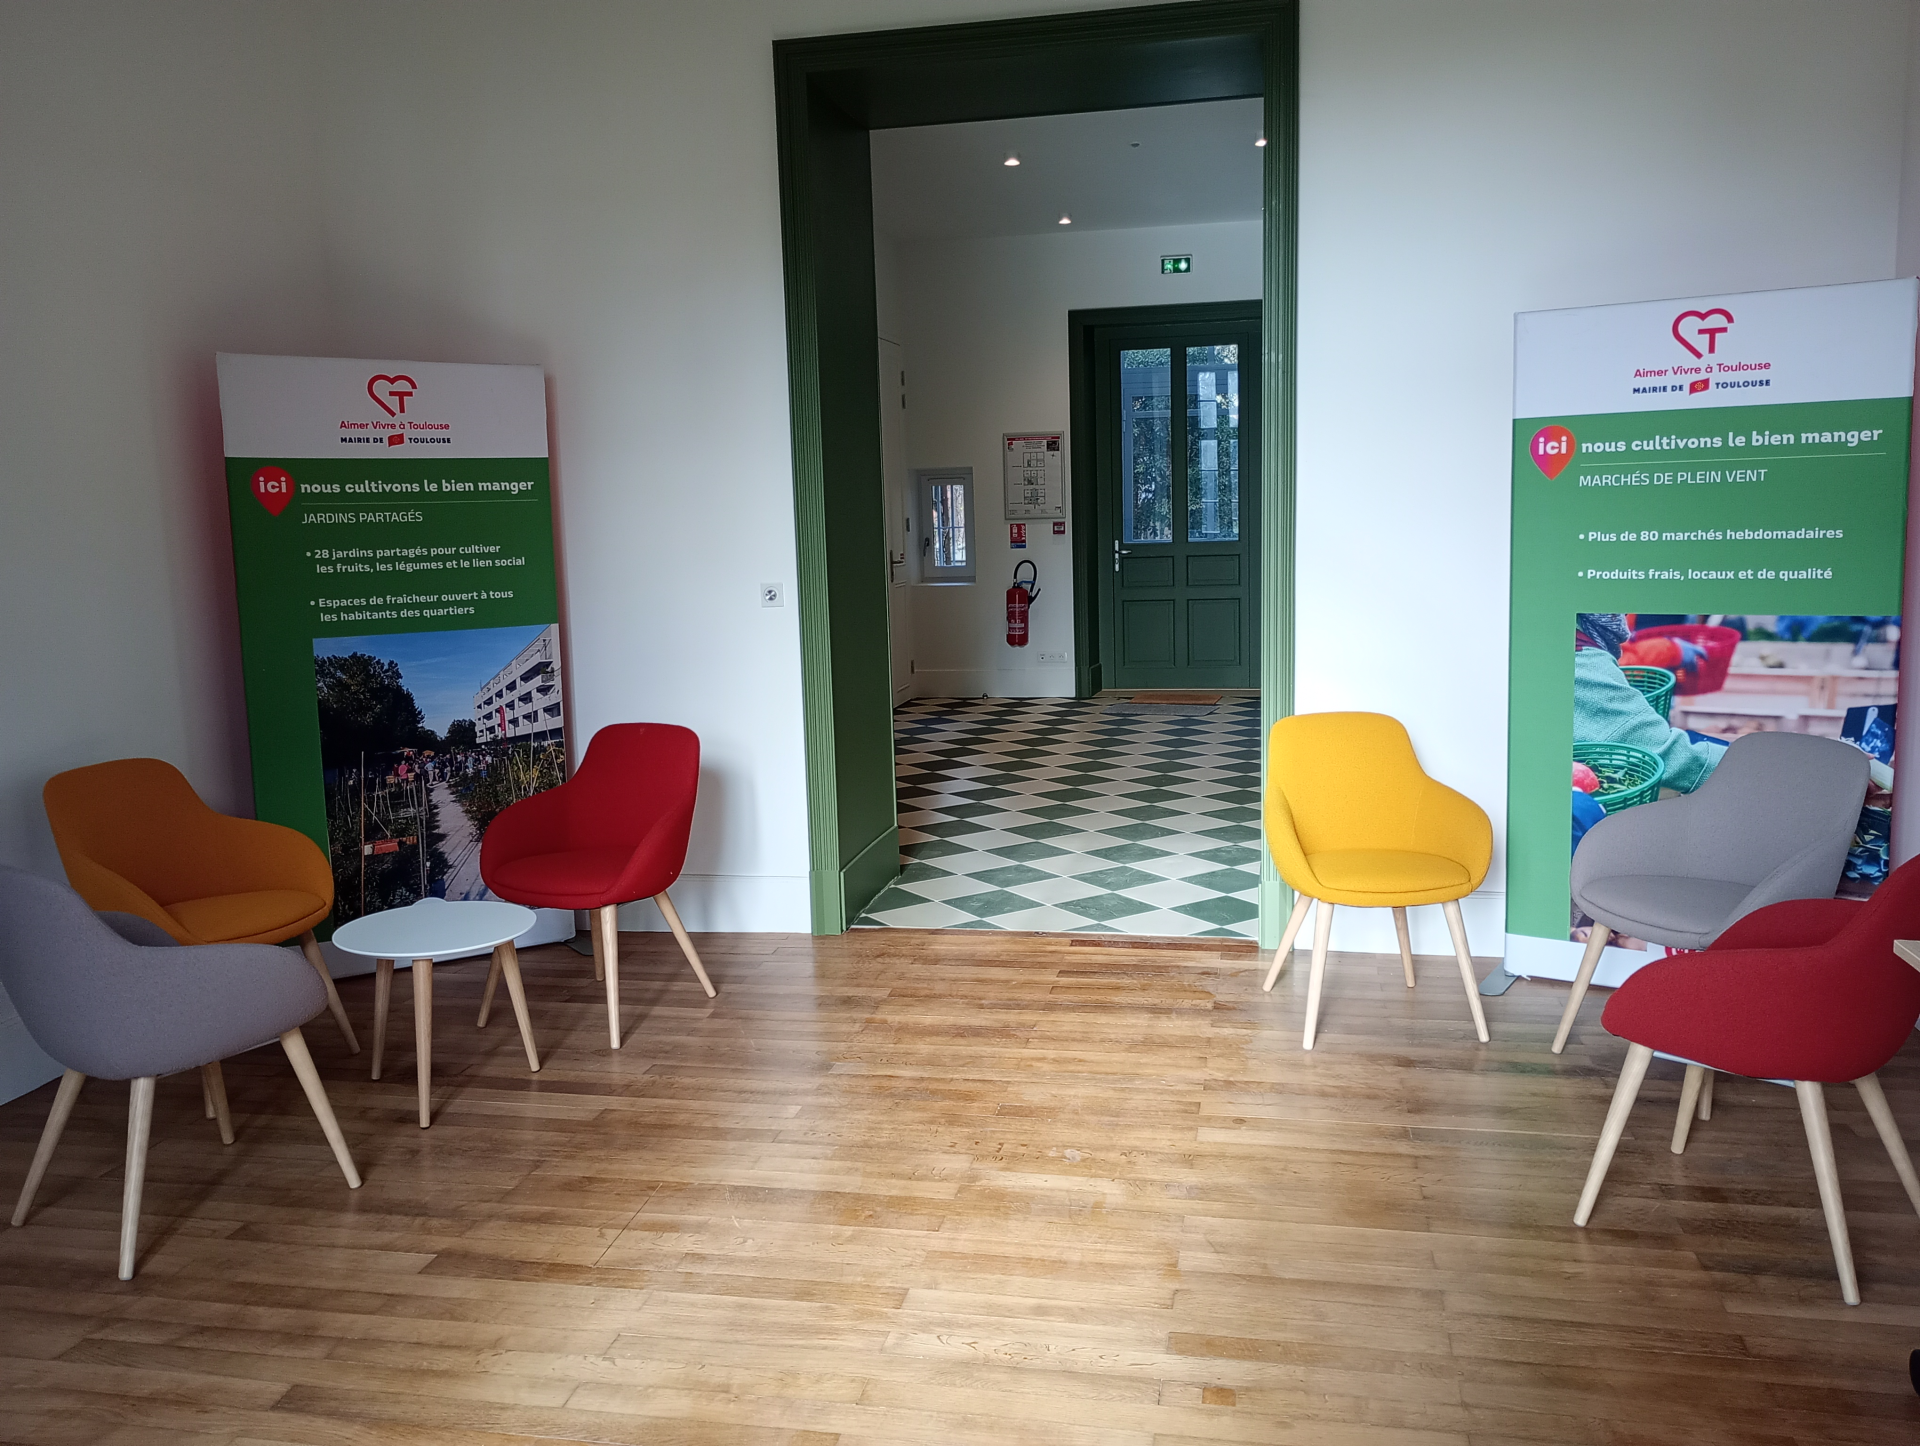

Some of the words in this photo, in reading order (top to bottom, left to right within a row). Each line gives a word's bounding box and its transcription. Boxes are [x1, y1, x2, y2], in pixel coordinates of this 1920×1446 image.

[1633, 369, 1669, 378] Aimer
[1671, 365, 1702, 376] Vivre
[1705, 364, 1713, 374] à
[1716, 361, 1771, 373] Toulouse
[1633, 385, 1668, 394] MAIRIE
[1671, 384, 1684, 392] DE
[1715, 379, 1771, 389] TOULOUSE
[339, 420, 370, 430] Aimer
[371, 421, 397, 430] Vivre
[399, 421, 406, 429] à
[407, 421, 450, 430] Toulouse
[1538, 436, 1568, 455] ici
[1581, 438, 1627, 454] nous
[1631, 434, 1723, 451] cultivons
[1728, 431, 1746, 447] le
[1751, 429, 1795, 446] bien
[1800, 427, 1883, 447] manger
[259, 476, 287, 494] ici
[300, 482, 341, 494] nous
[345, 480, 421, 493] cultivons
[424, 479, 439, 492] le
[442, 479, 474, 492] bien
[477, 479, 534, 495] manger
[1579, 470, 1650, 487] MARCHÉS
[1653, 472, 1673, 485] DE
[1677, 470, 1721, 484] PLEIN
[1725, 469, 1768, 483] VENT
[302, 512, 356, 524] JARDINS
[359, 510, 423, 523] PARTAGÉS
[1588, 530, 1617, 542] Plus
[1620, 530, 1637, 542] de
[1640, 530, 1659, 542] 80
[1662, 528, 1723, 542] marchés
[1726, 527, 1844, 541] hebdomadaires
[314, 549, 330, 559] 28
[331, 548, 374, 560] jardins
[376, 546, 428, 559] partagés
[430, 547, 456, 557] pour
[459, 544, 501, 554] cultiver
[316, 564, 334, 574] les
[336, 562, 374, 573] fruits,
[376, 561, 393, 572] les
[395, 559, 444, 573] légumes
[445, 559, 458, 569] et
[460, 559, 470, 568] le
[472, 558, 493, 568] lien
[495, 556, 526, 567] social
[1587, 568, 1646, 580] Produits
[1648, 568, 1685, 581] frais,
[1687, 568, 1735, 580] locaux
[1738, 568, 1754, 580] et
[1757, 567, 1776, 580] de
[1779, 567, 1833, 582] qualité
[318, 597, 367, 609] Espaces
[369, 595, 384, 606] de
[386, 593, 439, 605] fraîcheur
[441, 591, 479, 602] ouvert
[480, 589, 488, 600] à
[489, 589, 514, 599] tous
[320, 612, 338, 622] les
[340, 608, 398, 621] habitants
[400, 607, 421, 617] des
[423, 605, 475, 618] quartiers
